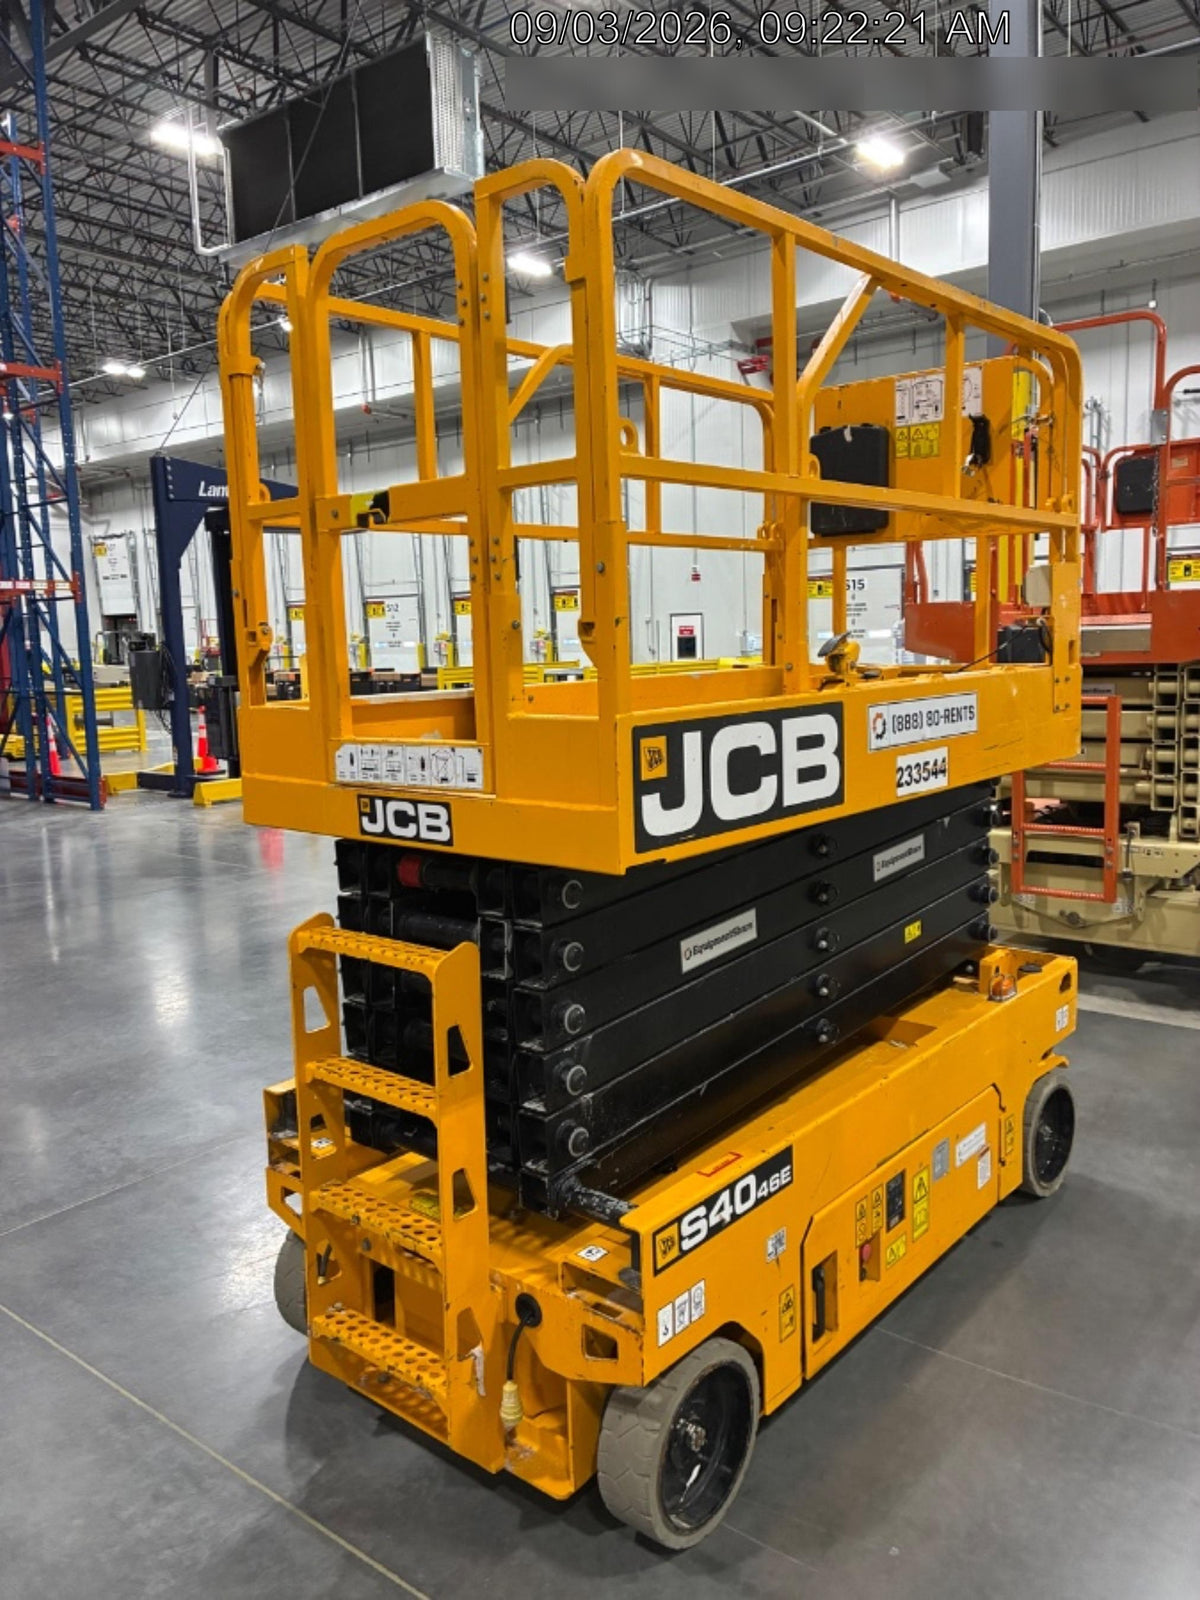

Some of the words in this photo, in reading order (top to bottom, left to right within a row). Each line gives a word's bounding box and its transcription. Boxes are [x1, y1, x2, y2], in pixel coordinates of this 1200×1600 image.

[892, 710, 923, 735] (888)
[926, 705, 975, 728] 80-RENTS
[641, 713, 841, 837] JCB
[896, 757, 947, 789] 233544
[361, 798, 451, 842] JCB
